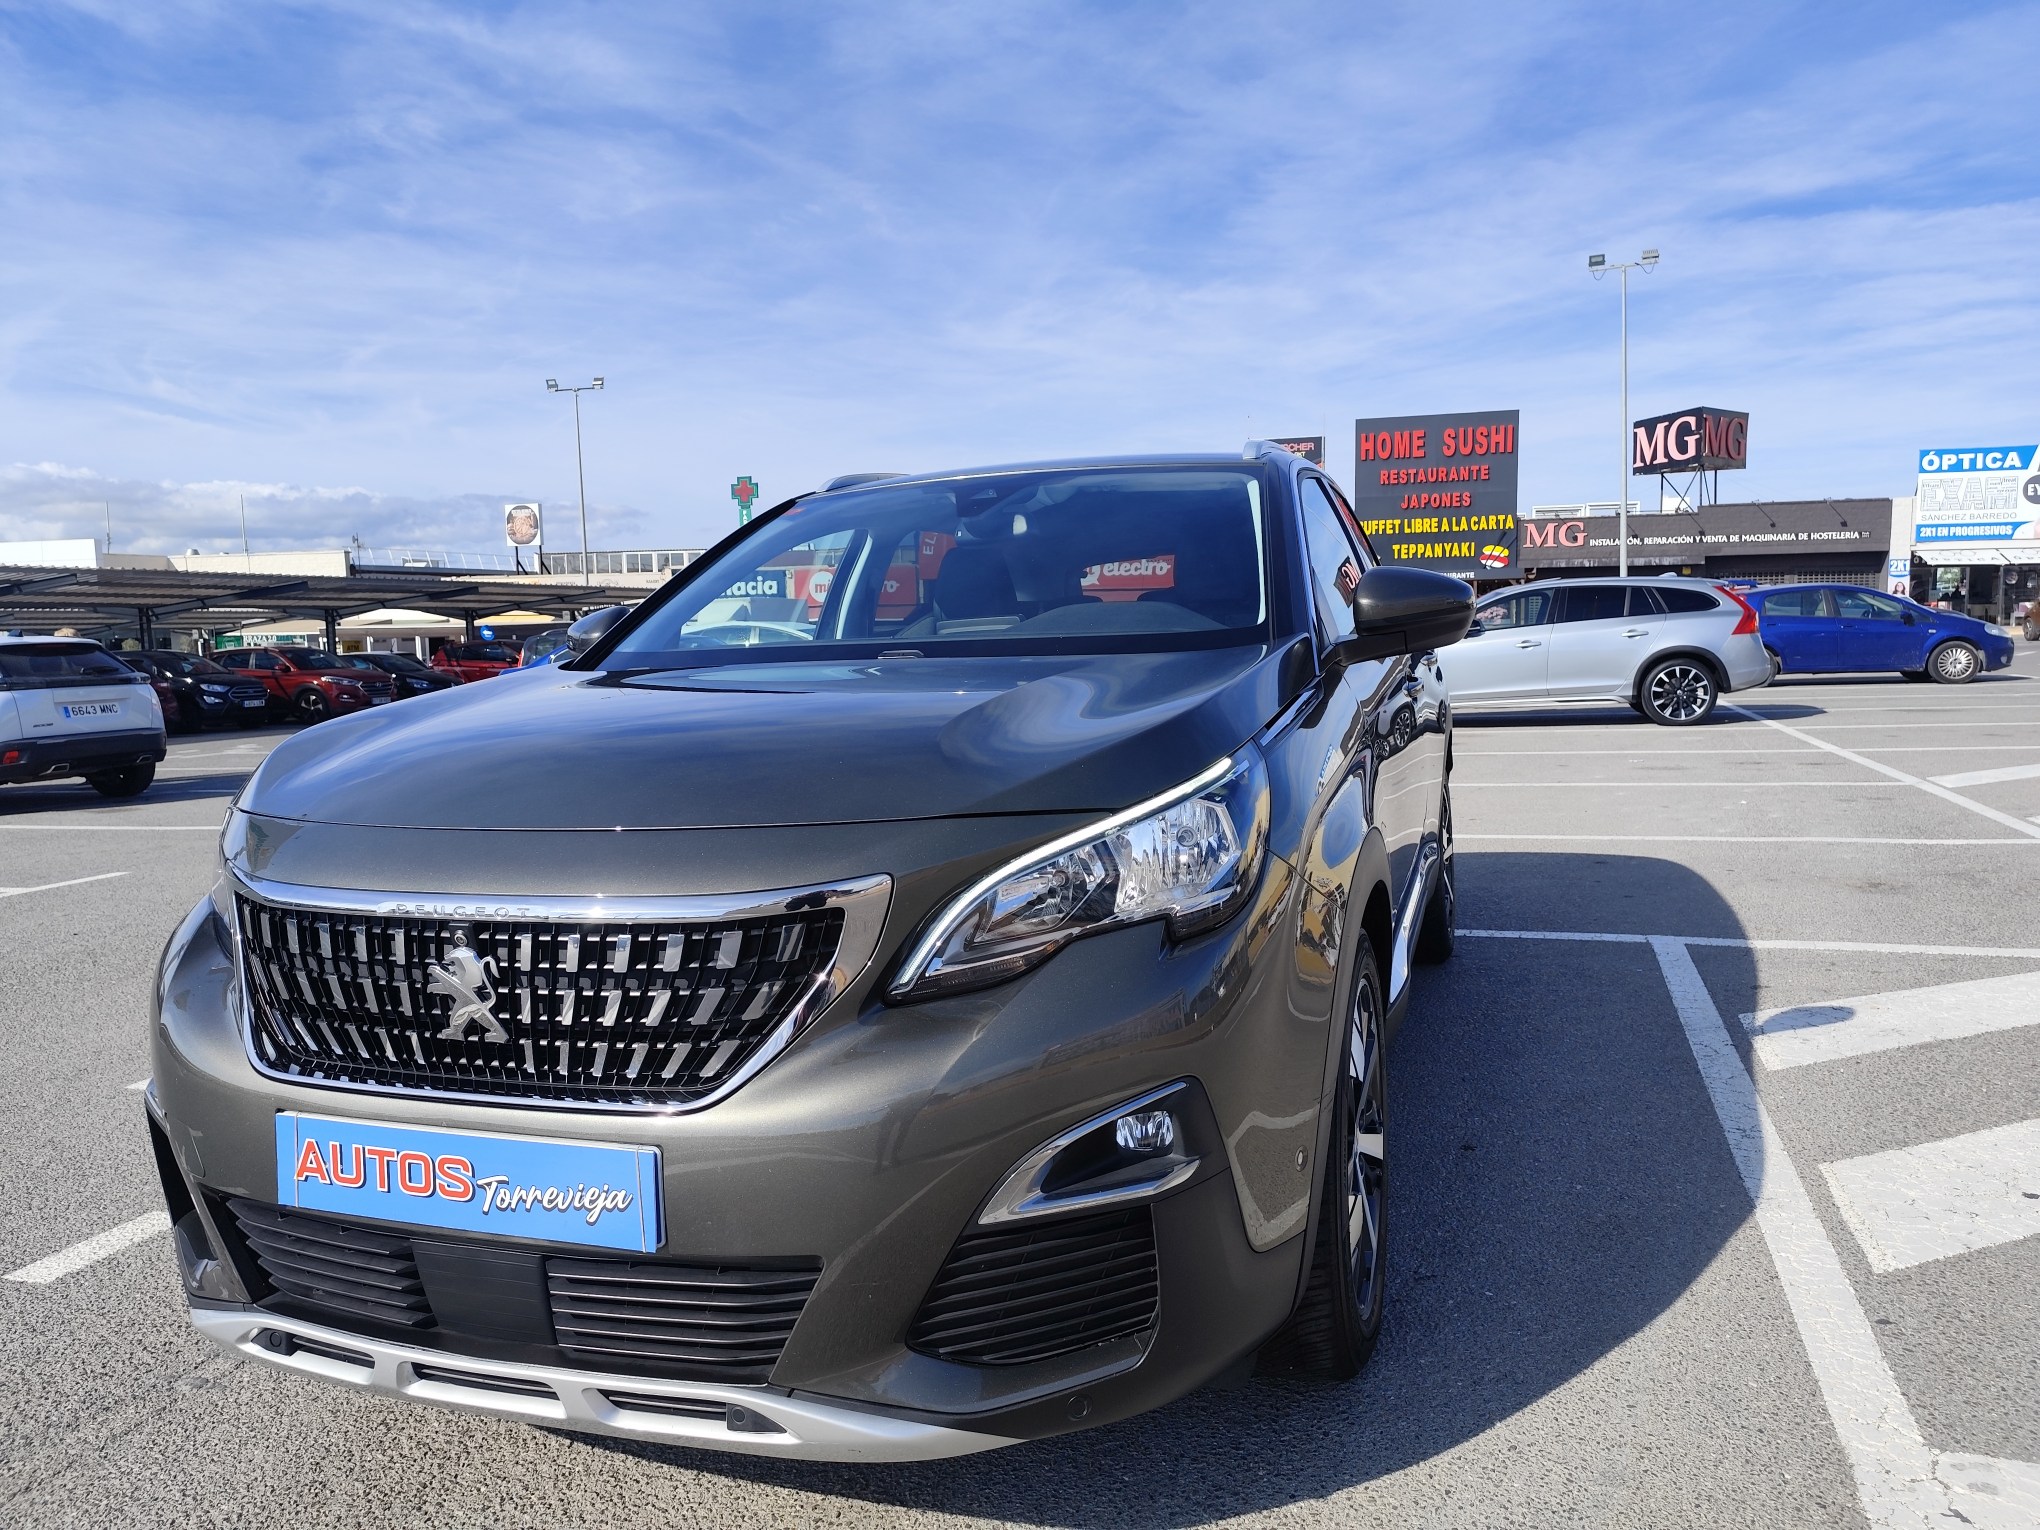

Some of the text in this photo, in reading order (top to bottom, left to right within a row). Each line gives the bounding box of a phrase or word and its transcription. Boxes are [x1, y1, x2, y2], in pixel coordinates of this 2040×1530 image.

[1360, 424, 1514, 461] HOME SUSHI
[1633, 416, 1700, 468] MG
[1703, 414, 1746, 460] MG
[1921, 451, 2022, 471] ÓPTICA
[1380, 465, 1490, 485] RESTAURANTE
[1400, 492, 1472, 509] JAPONES
[1404, 517, 1439, 534] LIBRE
[1441, 517, 1450, 532] A
[1452, 516, 1469, 532] LA
[1470, 514, 1515, 531] CARTA
[1969, 512, 2017, 520] BARREDO
[1523, 521, 1588, 548] MG
[1589, 536, 1642, 546] INSTALAÓN,
[1644, 535, 1694, 544] REPARACIÓN
[1702, 534, 1728, 543] VENTA
[1730, 534, 1740, 542] DE
[1741, 533, 1797, 542] MAQUINARIA
[1798, 533, 1808, 541] DE
[1920, 525, 2013, 537] 2X1 EN PROGRESIVOS
[1392, 541, 1475, 560] TEPPANYAKI
[1103, 559, 1171, 576] electro
[1890, 560, 1909, 572] 2X1
[71, 704, 118, 716] 6643 MNC
[395, 903, 531, 919] PEUGEOT
[294, 1138, 634, 1226] AUTOS Torrevieja
